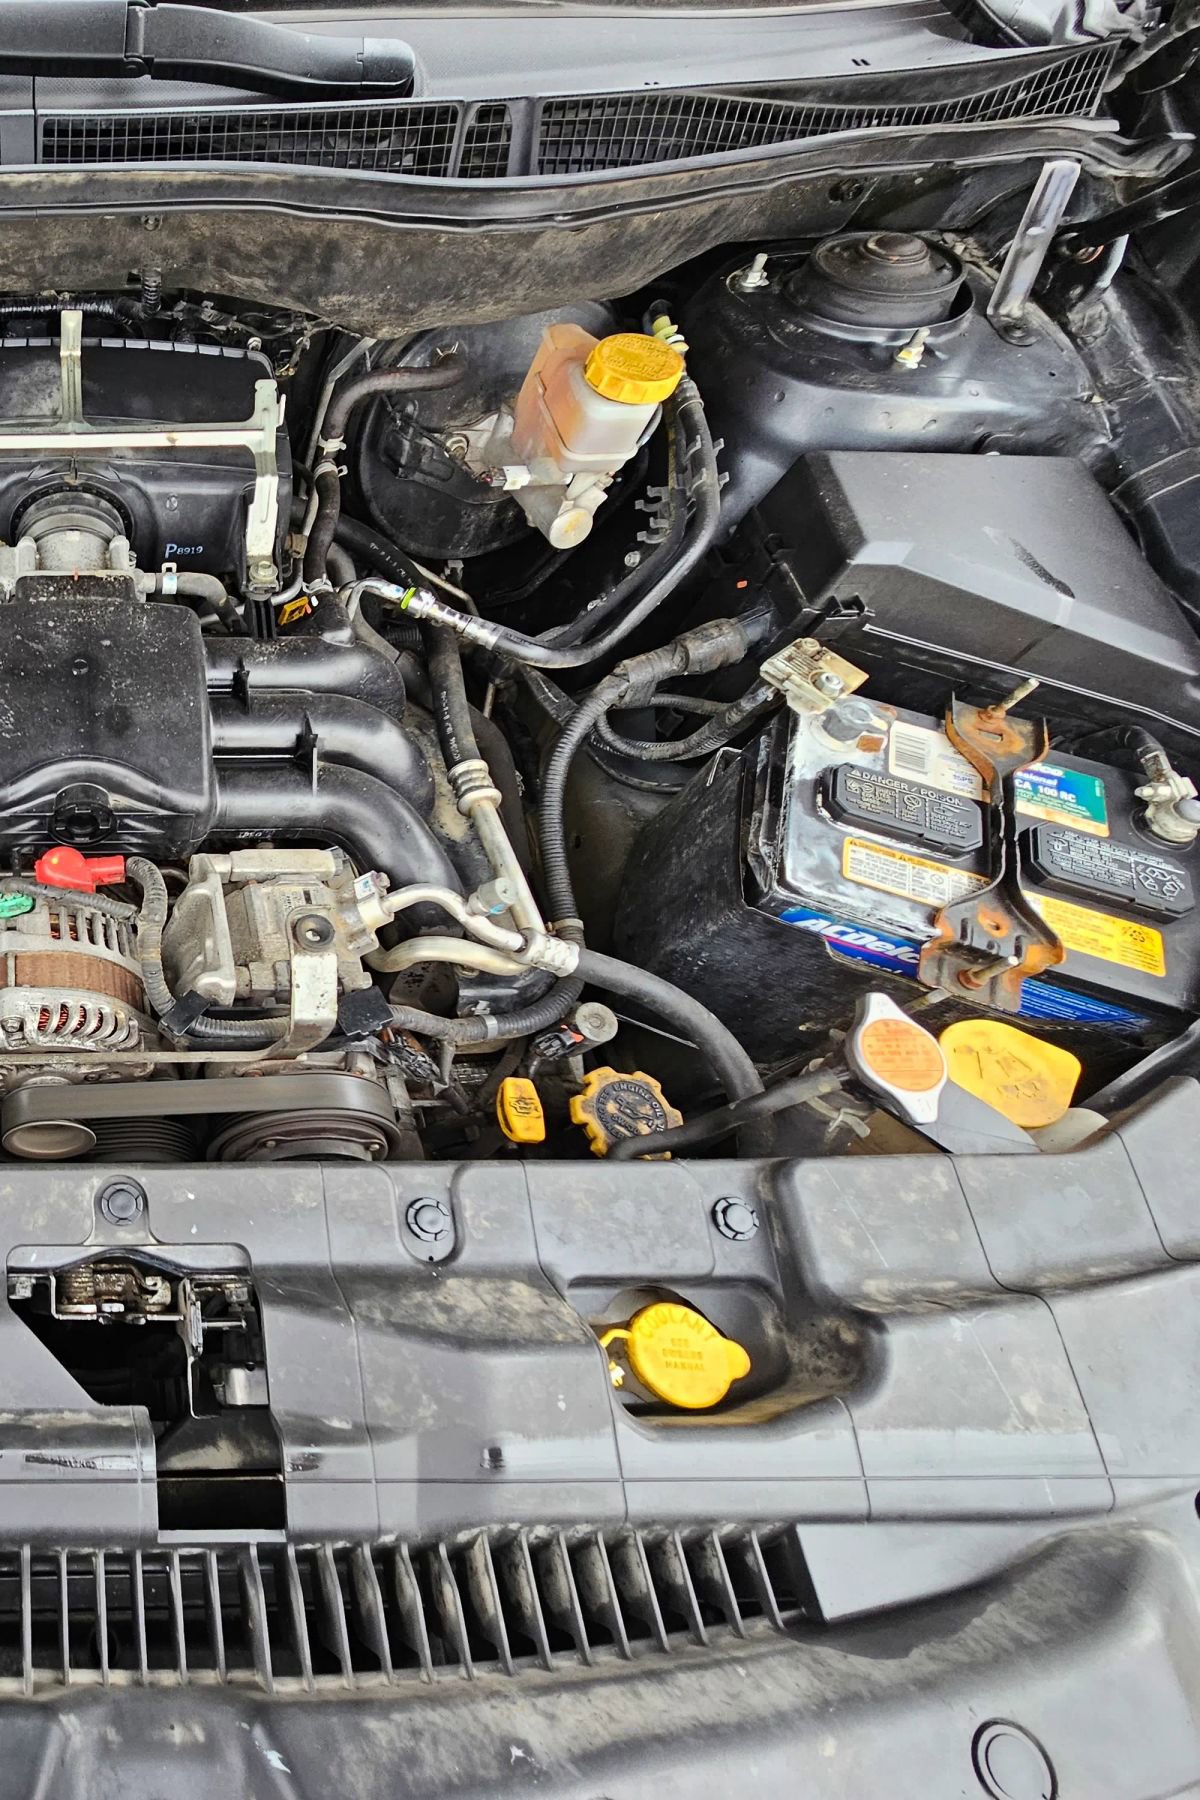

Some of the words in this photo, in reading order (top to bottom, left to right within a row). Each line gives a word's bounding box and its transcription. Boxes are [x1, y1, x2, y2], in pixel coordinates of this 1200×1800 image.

[164, 543, 204, 559] P8919
[862, 772, 909, 791] DANGER
[920, 787, 964, 806] POISON
[1038, 785, 1058, 797] 100
[1059, 790, 1077, 803] RC
[792, 918, 920, 964] ACDelc
[613, 1083, 652, 1102] ENGINE
[651, 1101, 662, 1119] OIL
[638, 1307, 718, 1341] COOLANT
